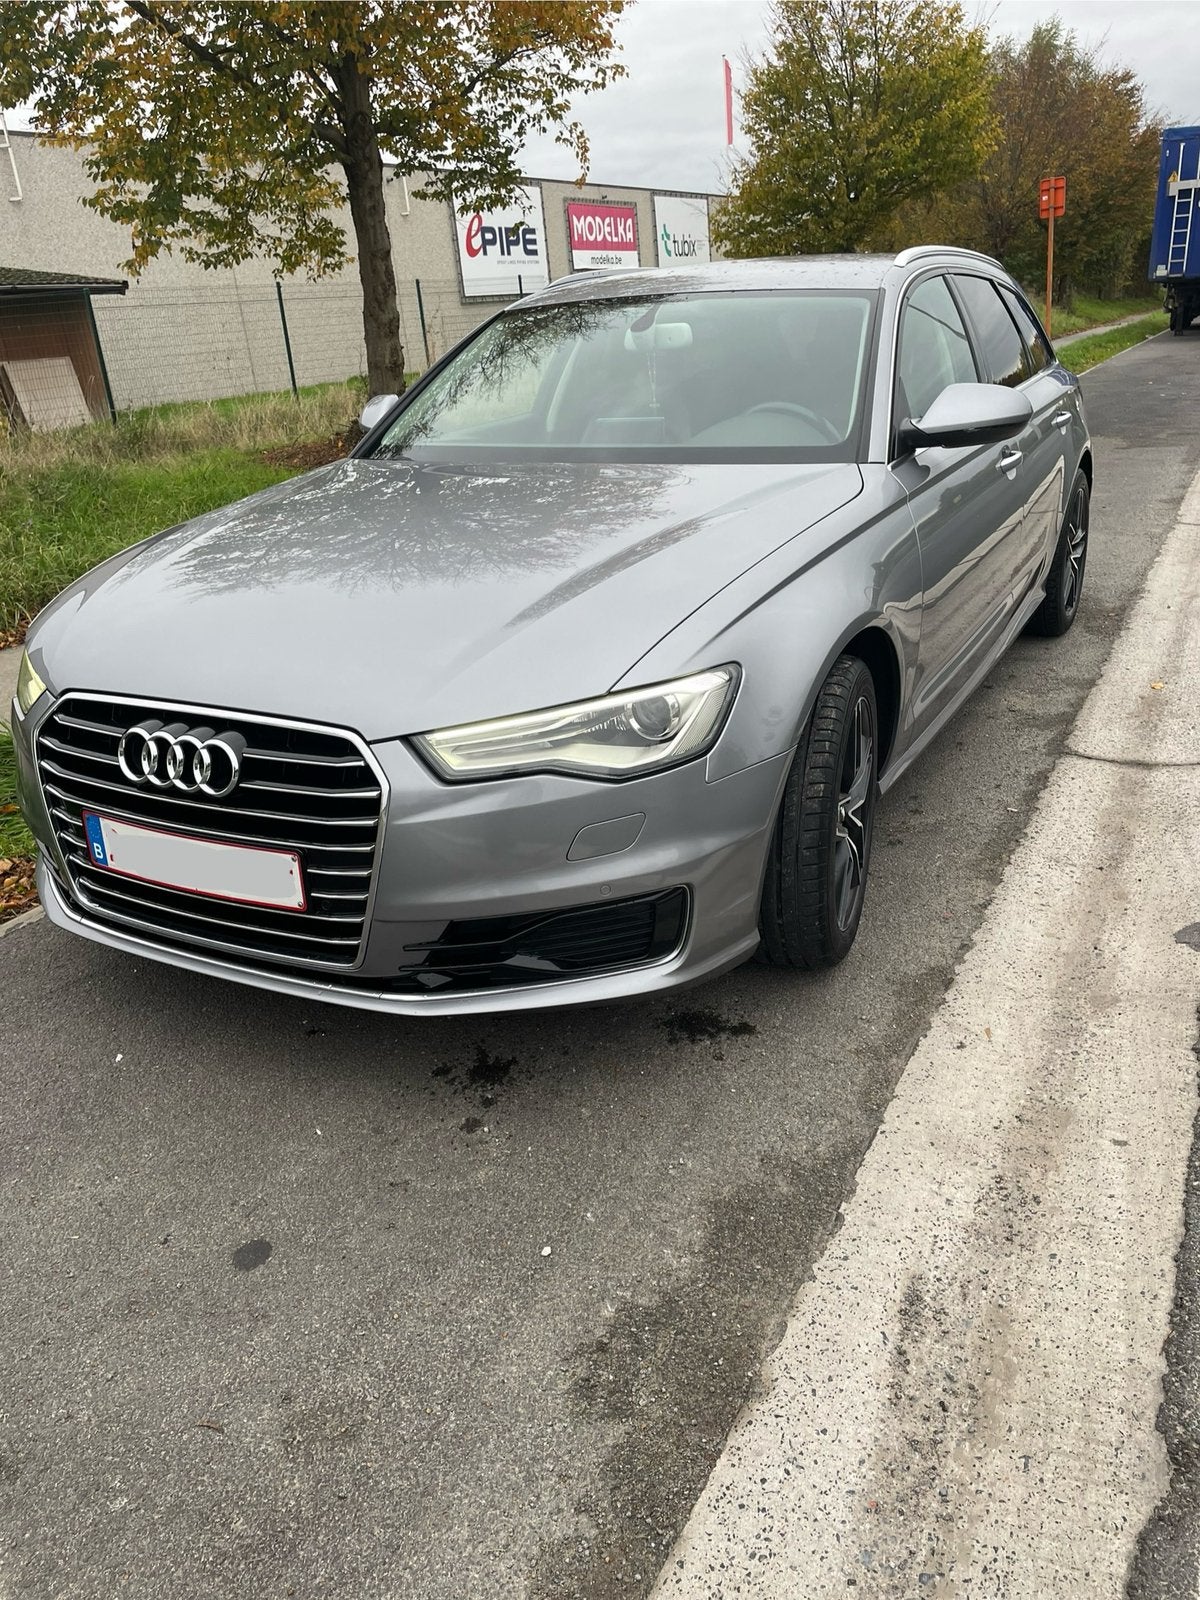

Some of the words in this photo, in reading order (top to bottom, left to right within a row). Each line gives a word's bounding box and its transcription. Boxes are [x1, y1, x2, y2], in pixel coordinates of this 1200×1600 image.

[572, 214, 634, 243] MODELKA
[672, 233, 698, 257] tubix
[590, 254, 623, 265] modelka.be
[93, 842, 103, 859] B
